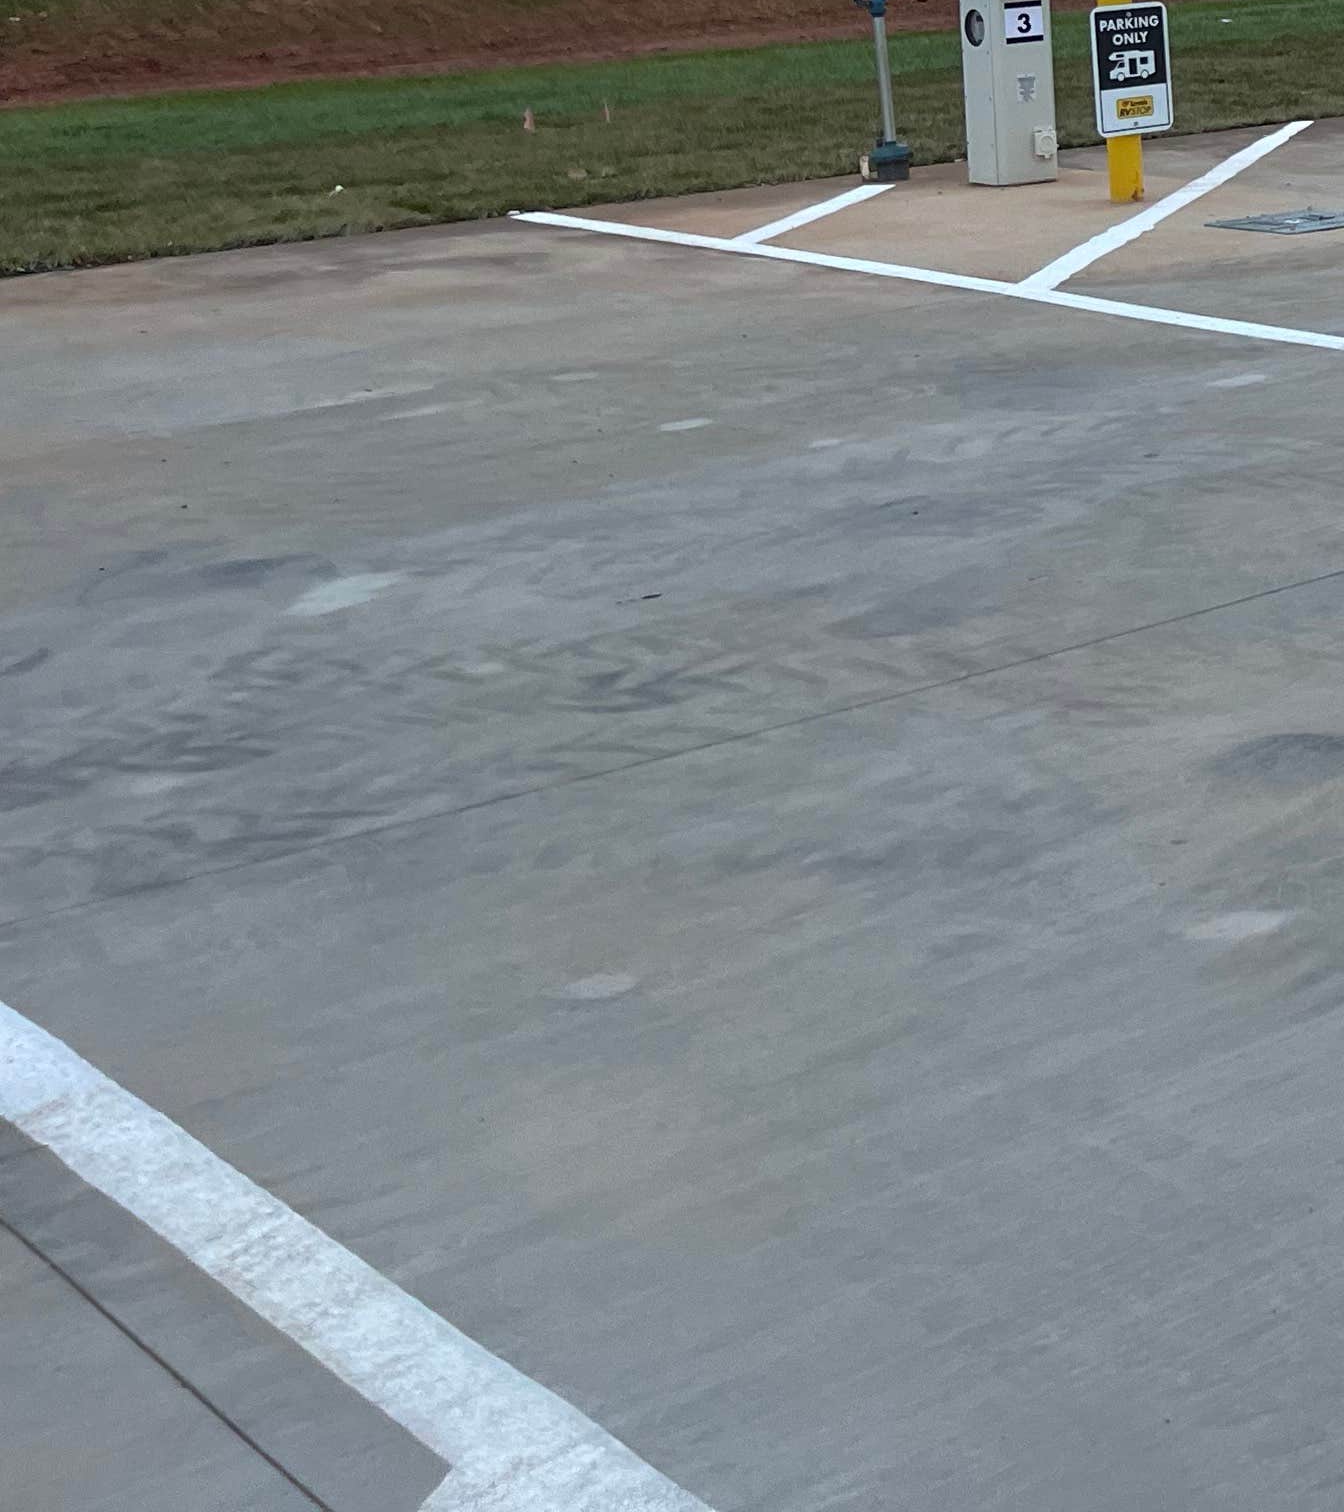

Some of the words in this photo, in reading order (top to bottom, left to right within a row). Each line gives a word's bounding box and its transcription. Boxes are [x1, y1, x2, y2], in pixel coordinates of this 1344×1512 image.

[1017, 13, 1032, 33] 3
[1099, 15, 1160, 32] PARKING
[1112, 31, 1148, 45] ONLY
